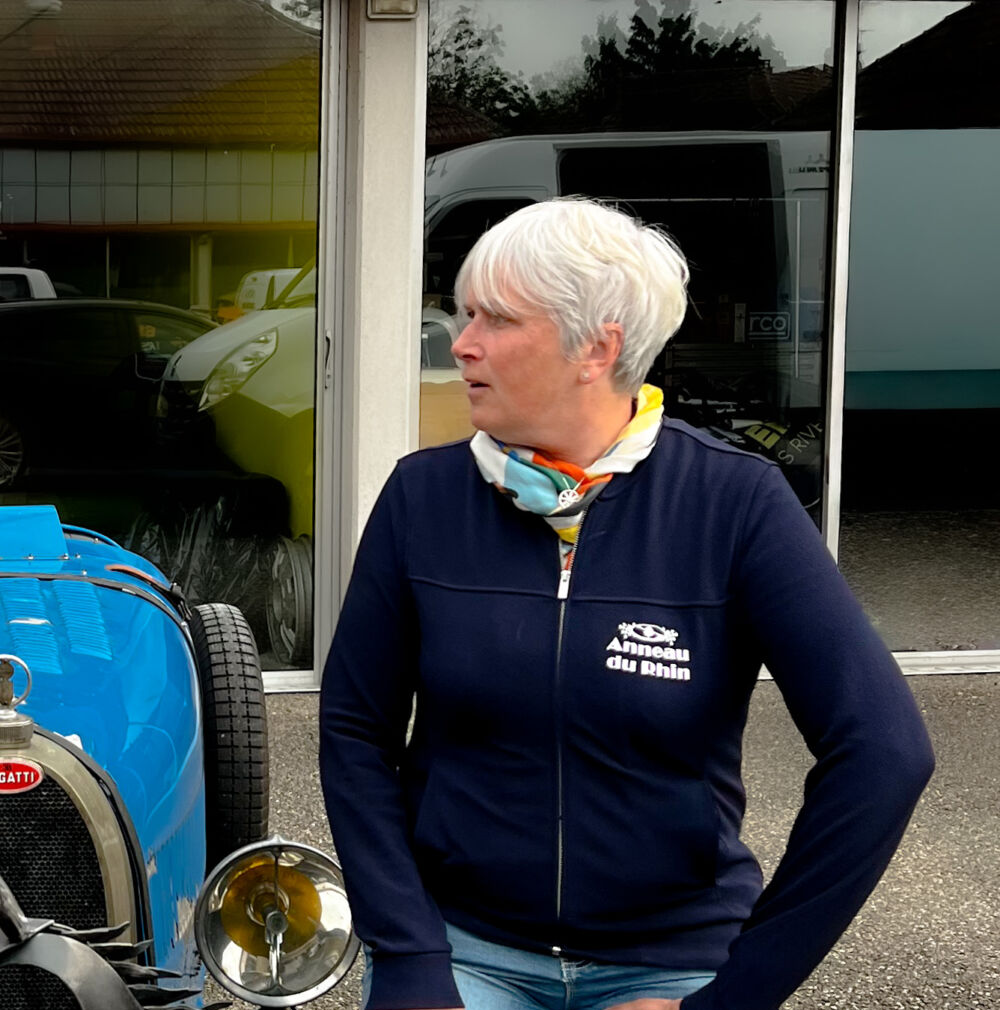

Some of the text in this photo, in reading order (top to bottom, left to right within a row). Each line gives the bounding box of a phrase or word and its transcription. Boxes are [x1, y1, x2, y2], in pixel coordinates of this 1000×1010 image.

[606, 636, 690, 661] Anneau
[606, 655, 691, 681] du Rhin
